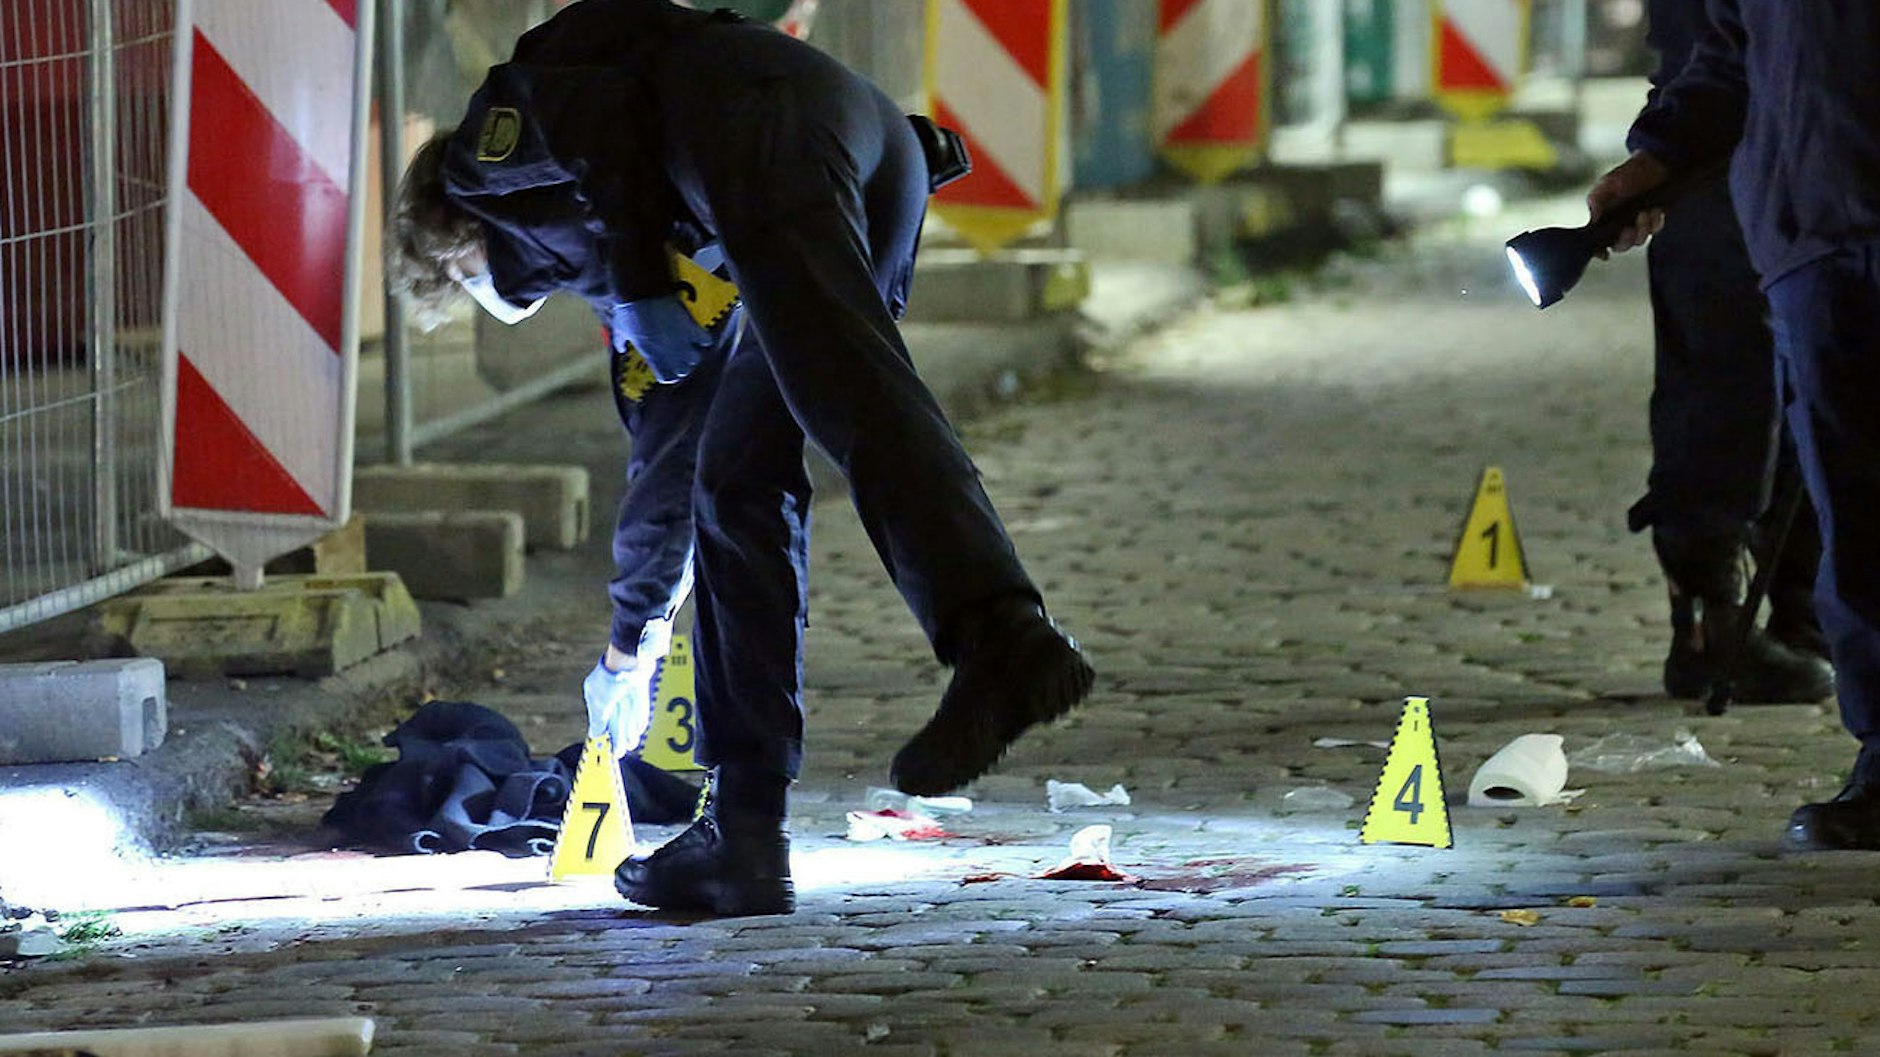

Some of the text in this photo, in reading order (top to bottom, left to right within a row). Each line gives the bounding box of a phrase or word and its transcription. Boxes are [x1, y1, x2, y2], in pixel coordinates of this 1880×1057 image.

[1481, 520, 1499, 571] 1
[666, 696, 695, 754] 3
[1392, 764, 1425, 825] 4
[582, 801, 611, 861] 7
